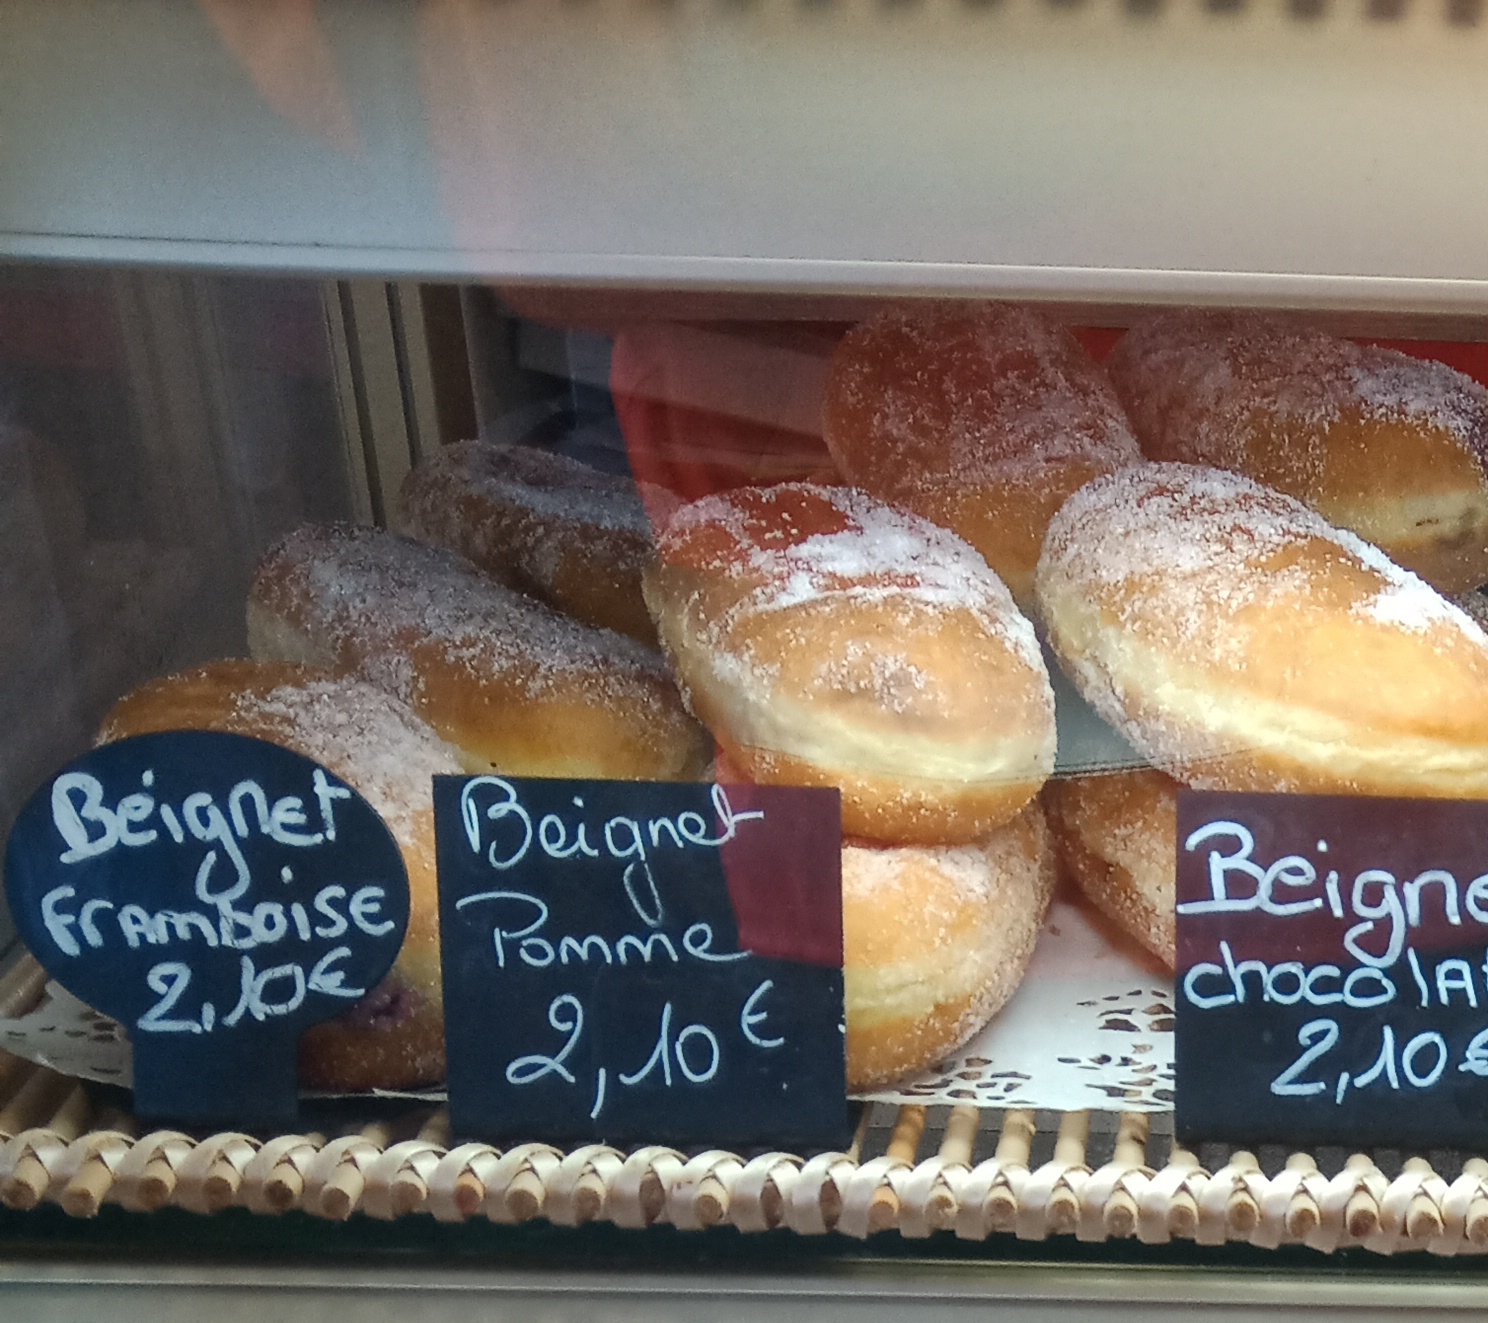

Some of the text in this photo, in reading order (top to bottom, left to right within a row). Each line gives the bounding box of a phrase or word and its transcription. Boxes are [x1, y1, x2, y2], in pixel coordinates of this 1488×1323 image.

[461, 776, 764, 927] Beignet
[456, 891, 752, 967] Pomme
[136, 946, 366, 1034] 2,10€
